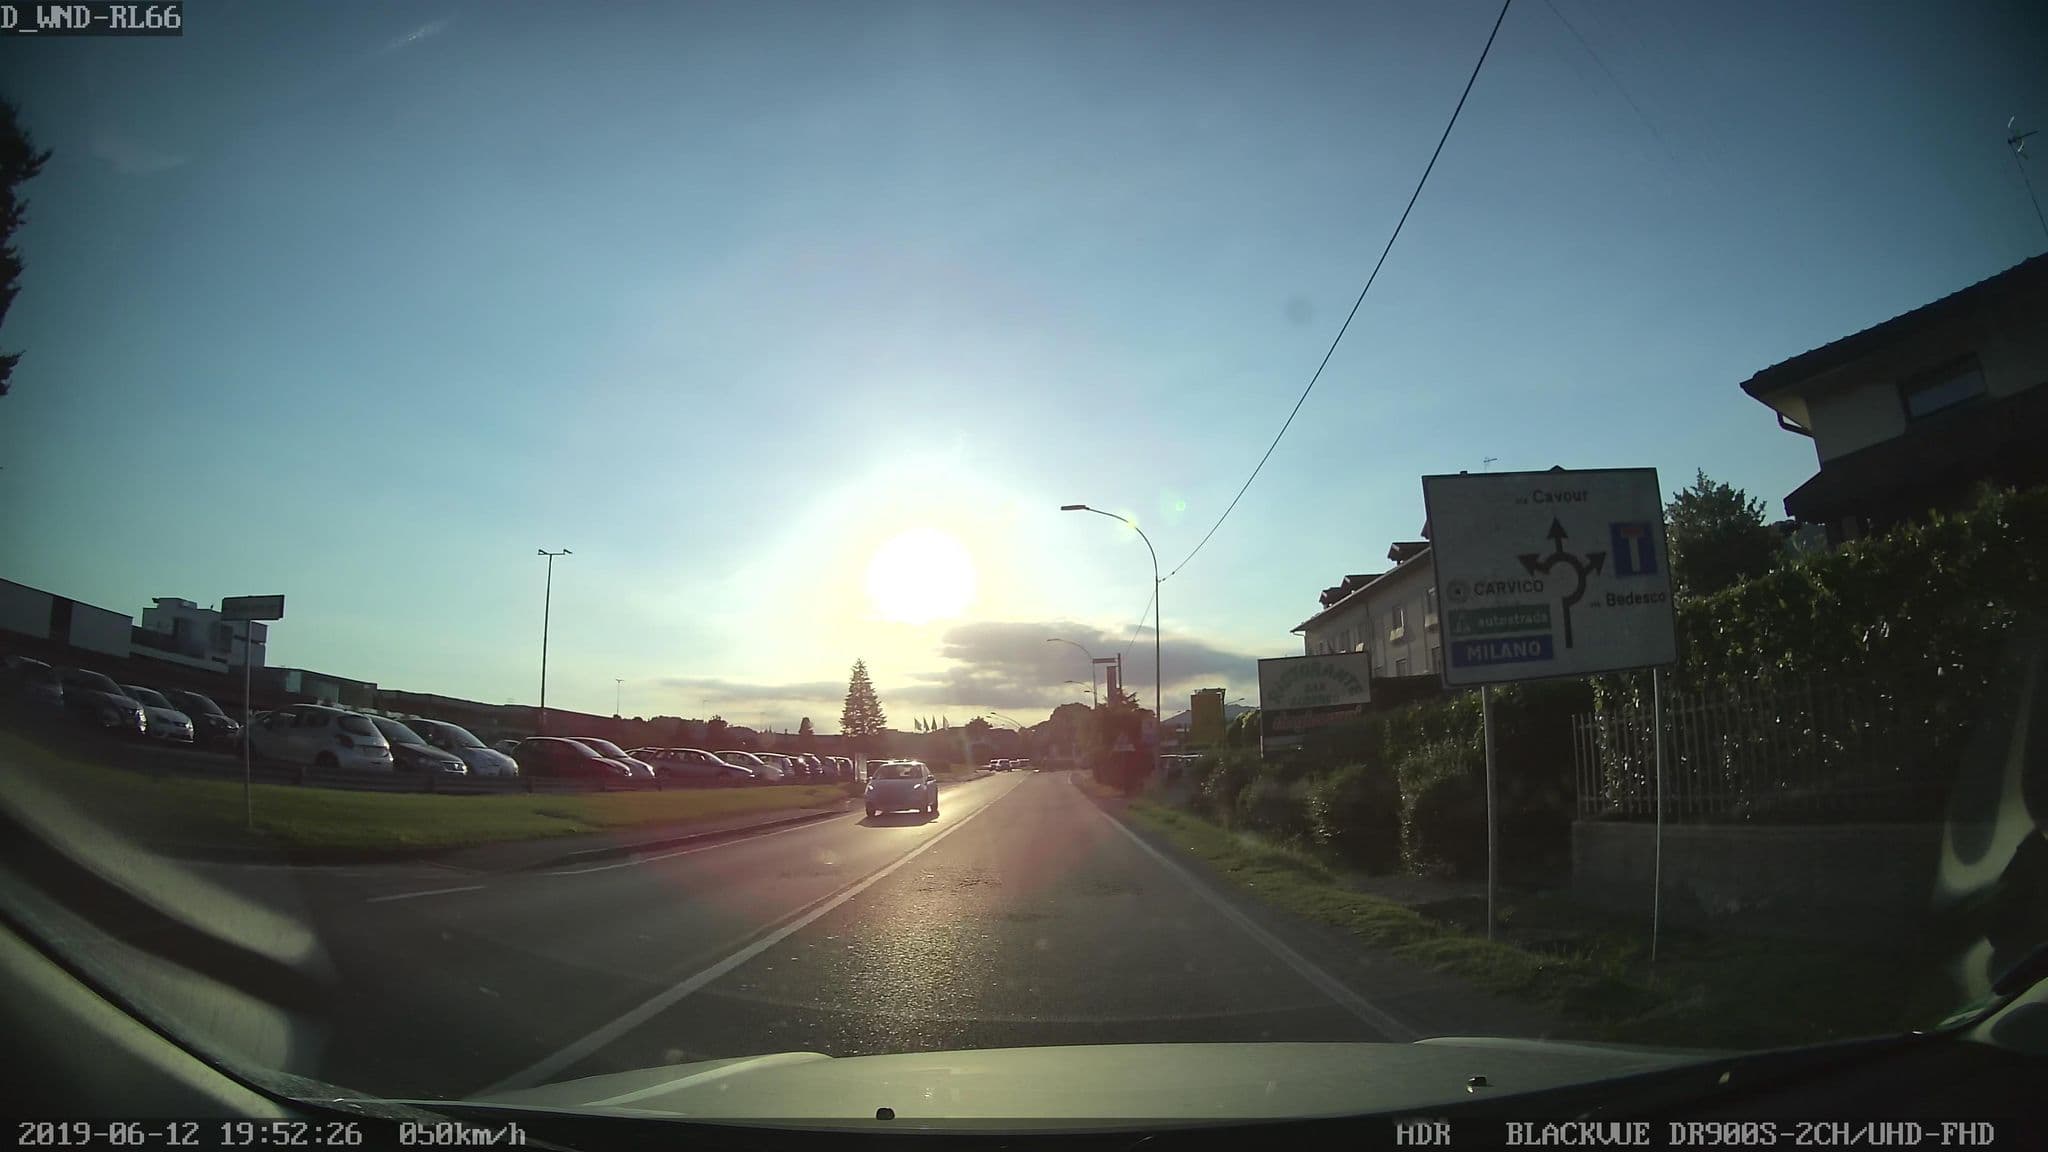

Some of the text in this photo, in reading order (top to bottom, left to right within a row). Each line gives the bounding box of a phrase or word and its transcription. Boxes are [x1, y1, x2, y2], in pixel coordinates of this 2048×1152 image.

[1532, 487, 1588, 504] Cavour
[1473, 579, 1544, 596] CARVICO
[1606, 591, 1666, 607] Bedesco
[1477, 609, 1549, 628] autostrada
[1466, 640, 1542, 661] MILANO
[1267, 662, 1363, 704] RISTORANTE
